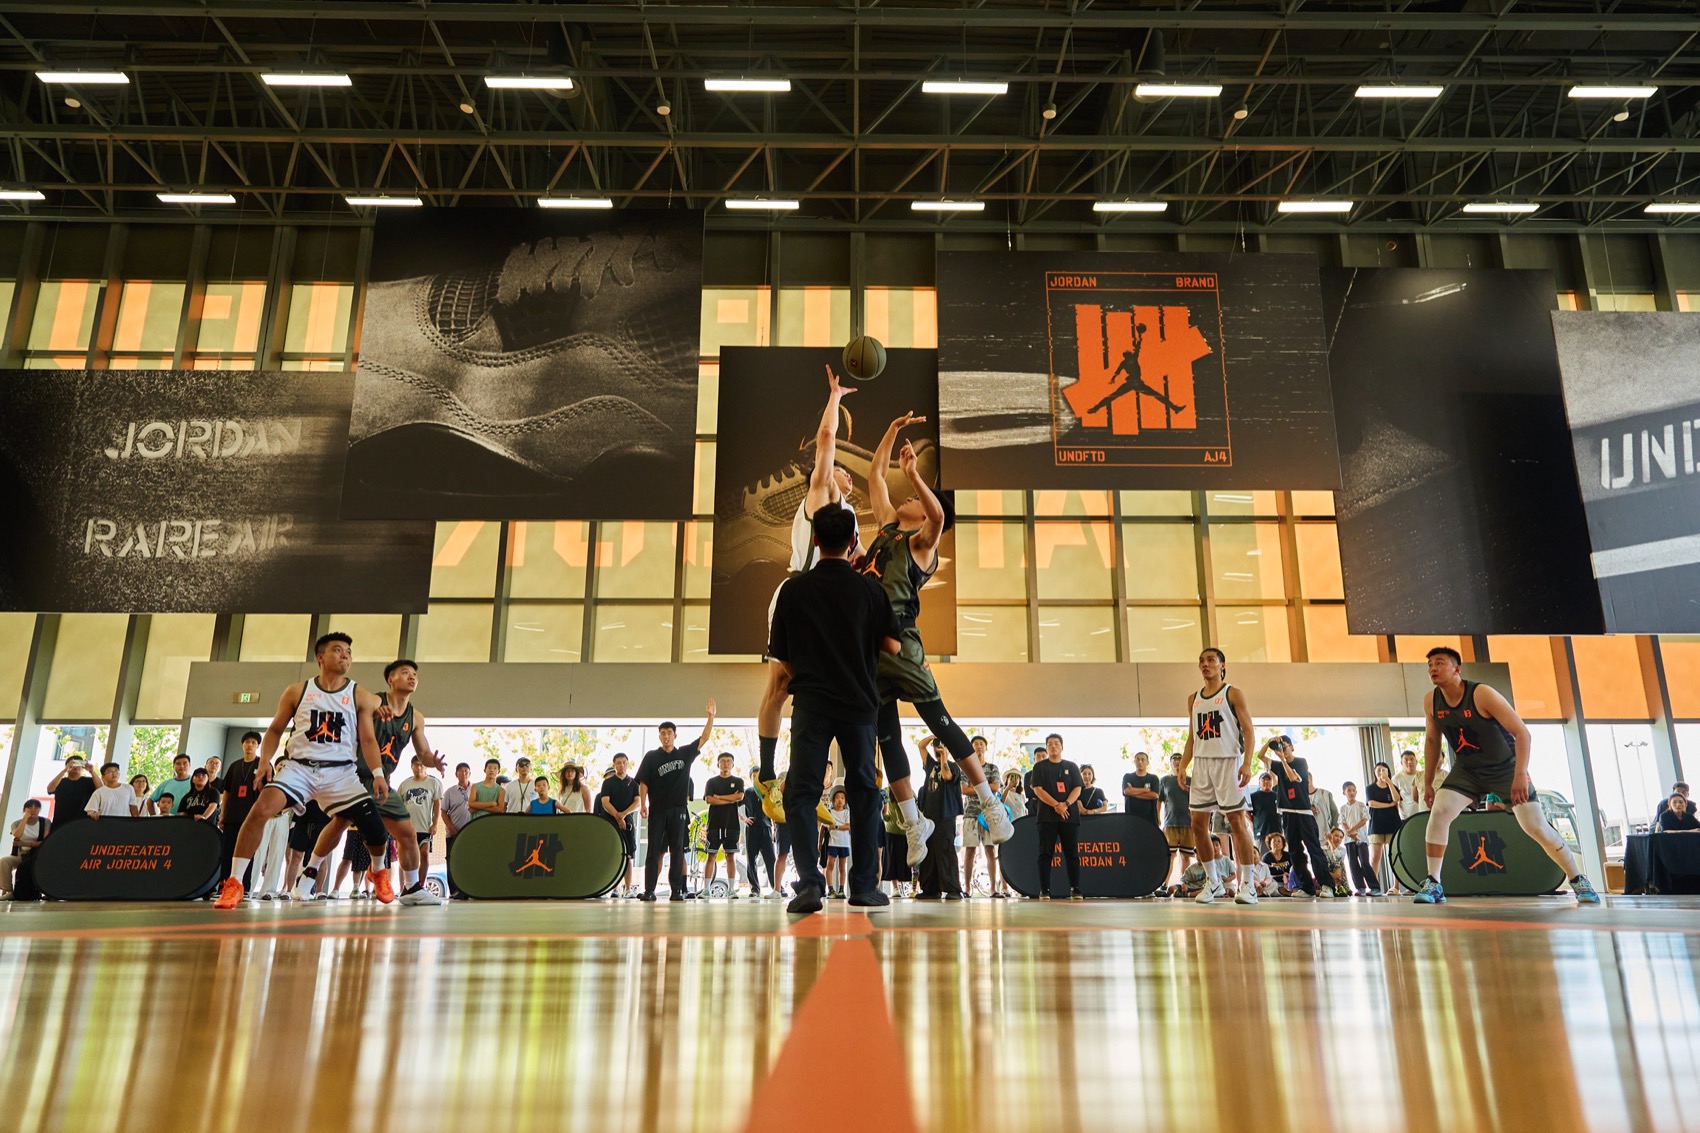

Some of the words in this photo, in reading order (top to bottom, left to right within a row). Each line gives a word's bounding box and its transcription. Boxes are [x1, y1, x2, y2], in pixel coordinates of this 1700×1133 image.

[1050, 276, 1097, 288] JORDAN
[1176, 276, 1215, 288] BRAND
[104, 418, 302, 459] JORDAN
[1059, 450, 1105, 462] UNDFTD
[1204, 450, 1227, 463] AJ4
[84, 519, 222, 558] RARE
[225, 514, 295, 554] AIR
[90, 844, 171, 856] UNDEFEATED
[1054, 842, 1120, 853] NFEATED
[80, 859, 101, 870] AIR
[107, 859, 158, 870] JORDAN
[163, 859, 172, 870] 4
[1118, 856, 1126, 867] 4
